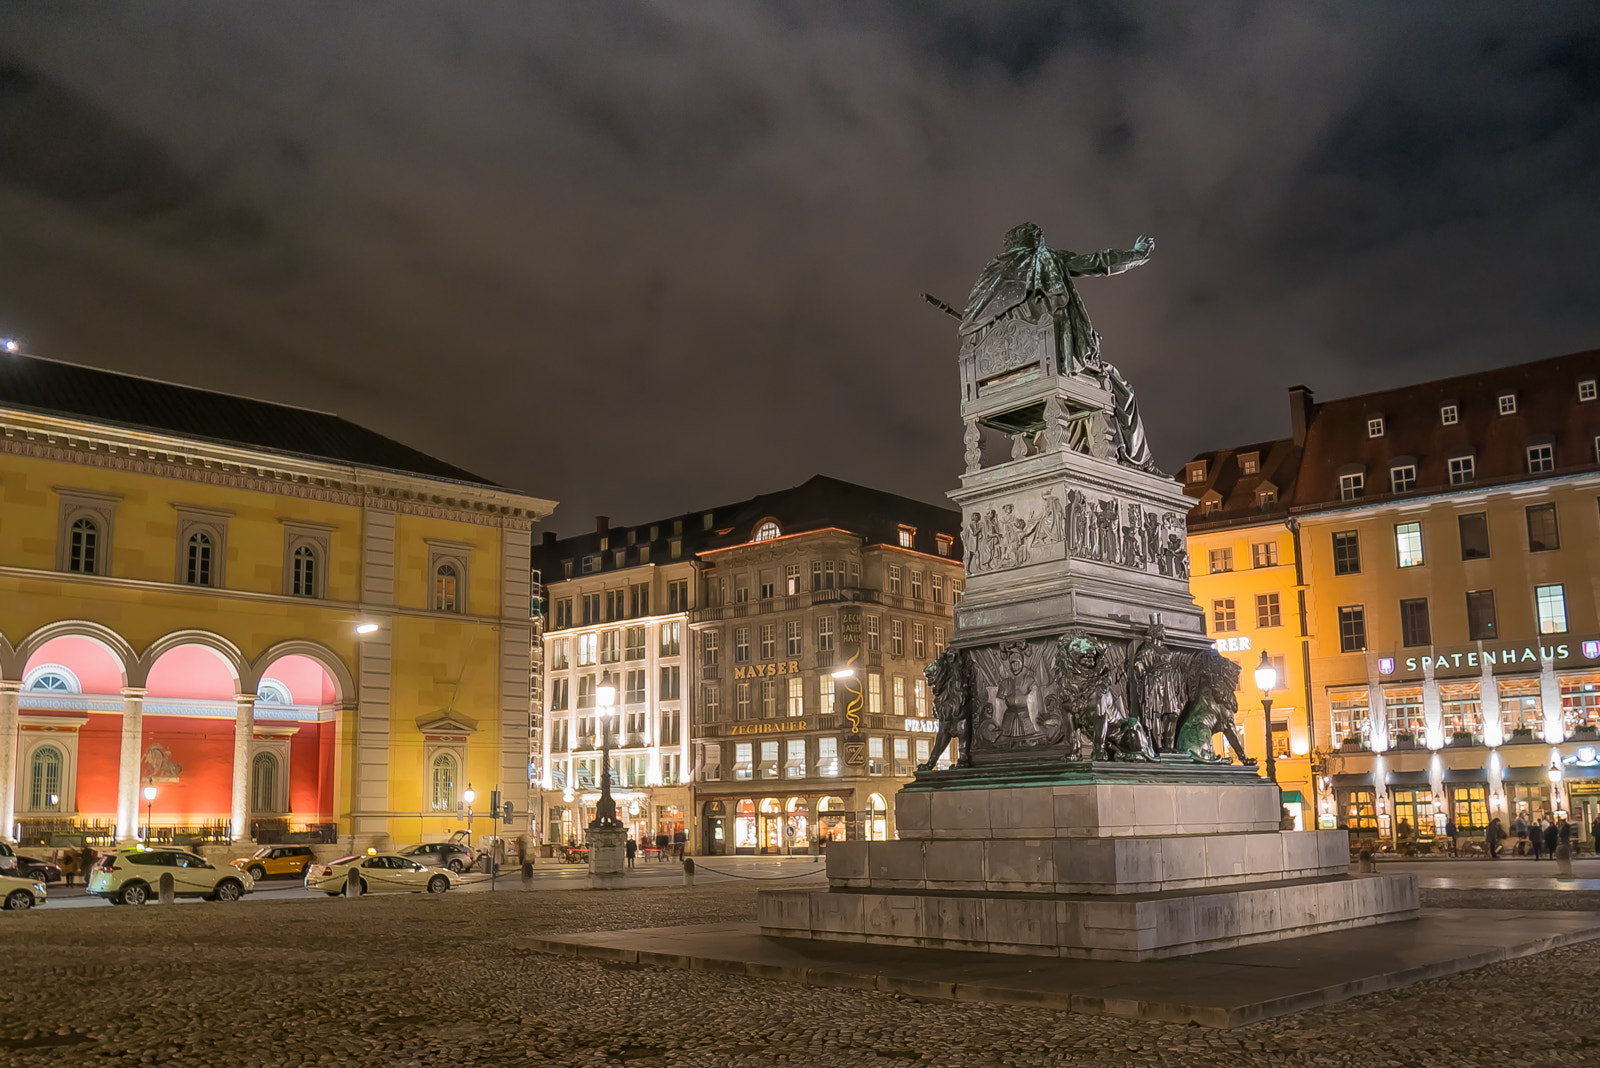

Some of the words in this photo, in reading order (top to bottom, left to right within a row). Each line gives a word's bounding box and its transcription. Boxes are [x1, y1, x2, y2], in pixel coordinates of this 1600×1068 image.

[843, 633, 862, 643] HAUS
[1211, 636, 1251, 653] RER
[1405, 644, 1569, 671] SPATENHAUS
[734, 660, 799, 679] MAYSER
[731, 720, 807, 735] ZECHBAUER
[712, 801, 719, 811] Z
